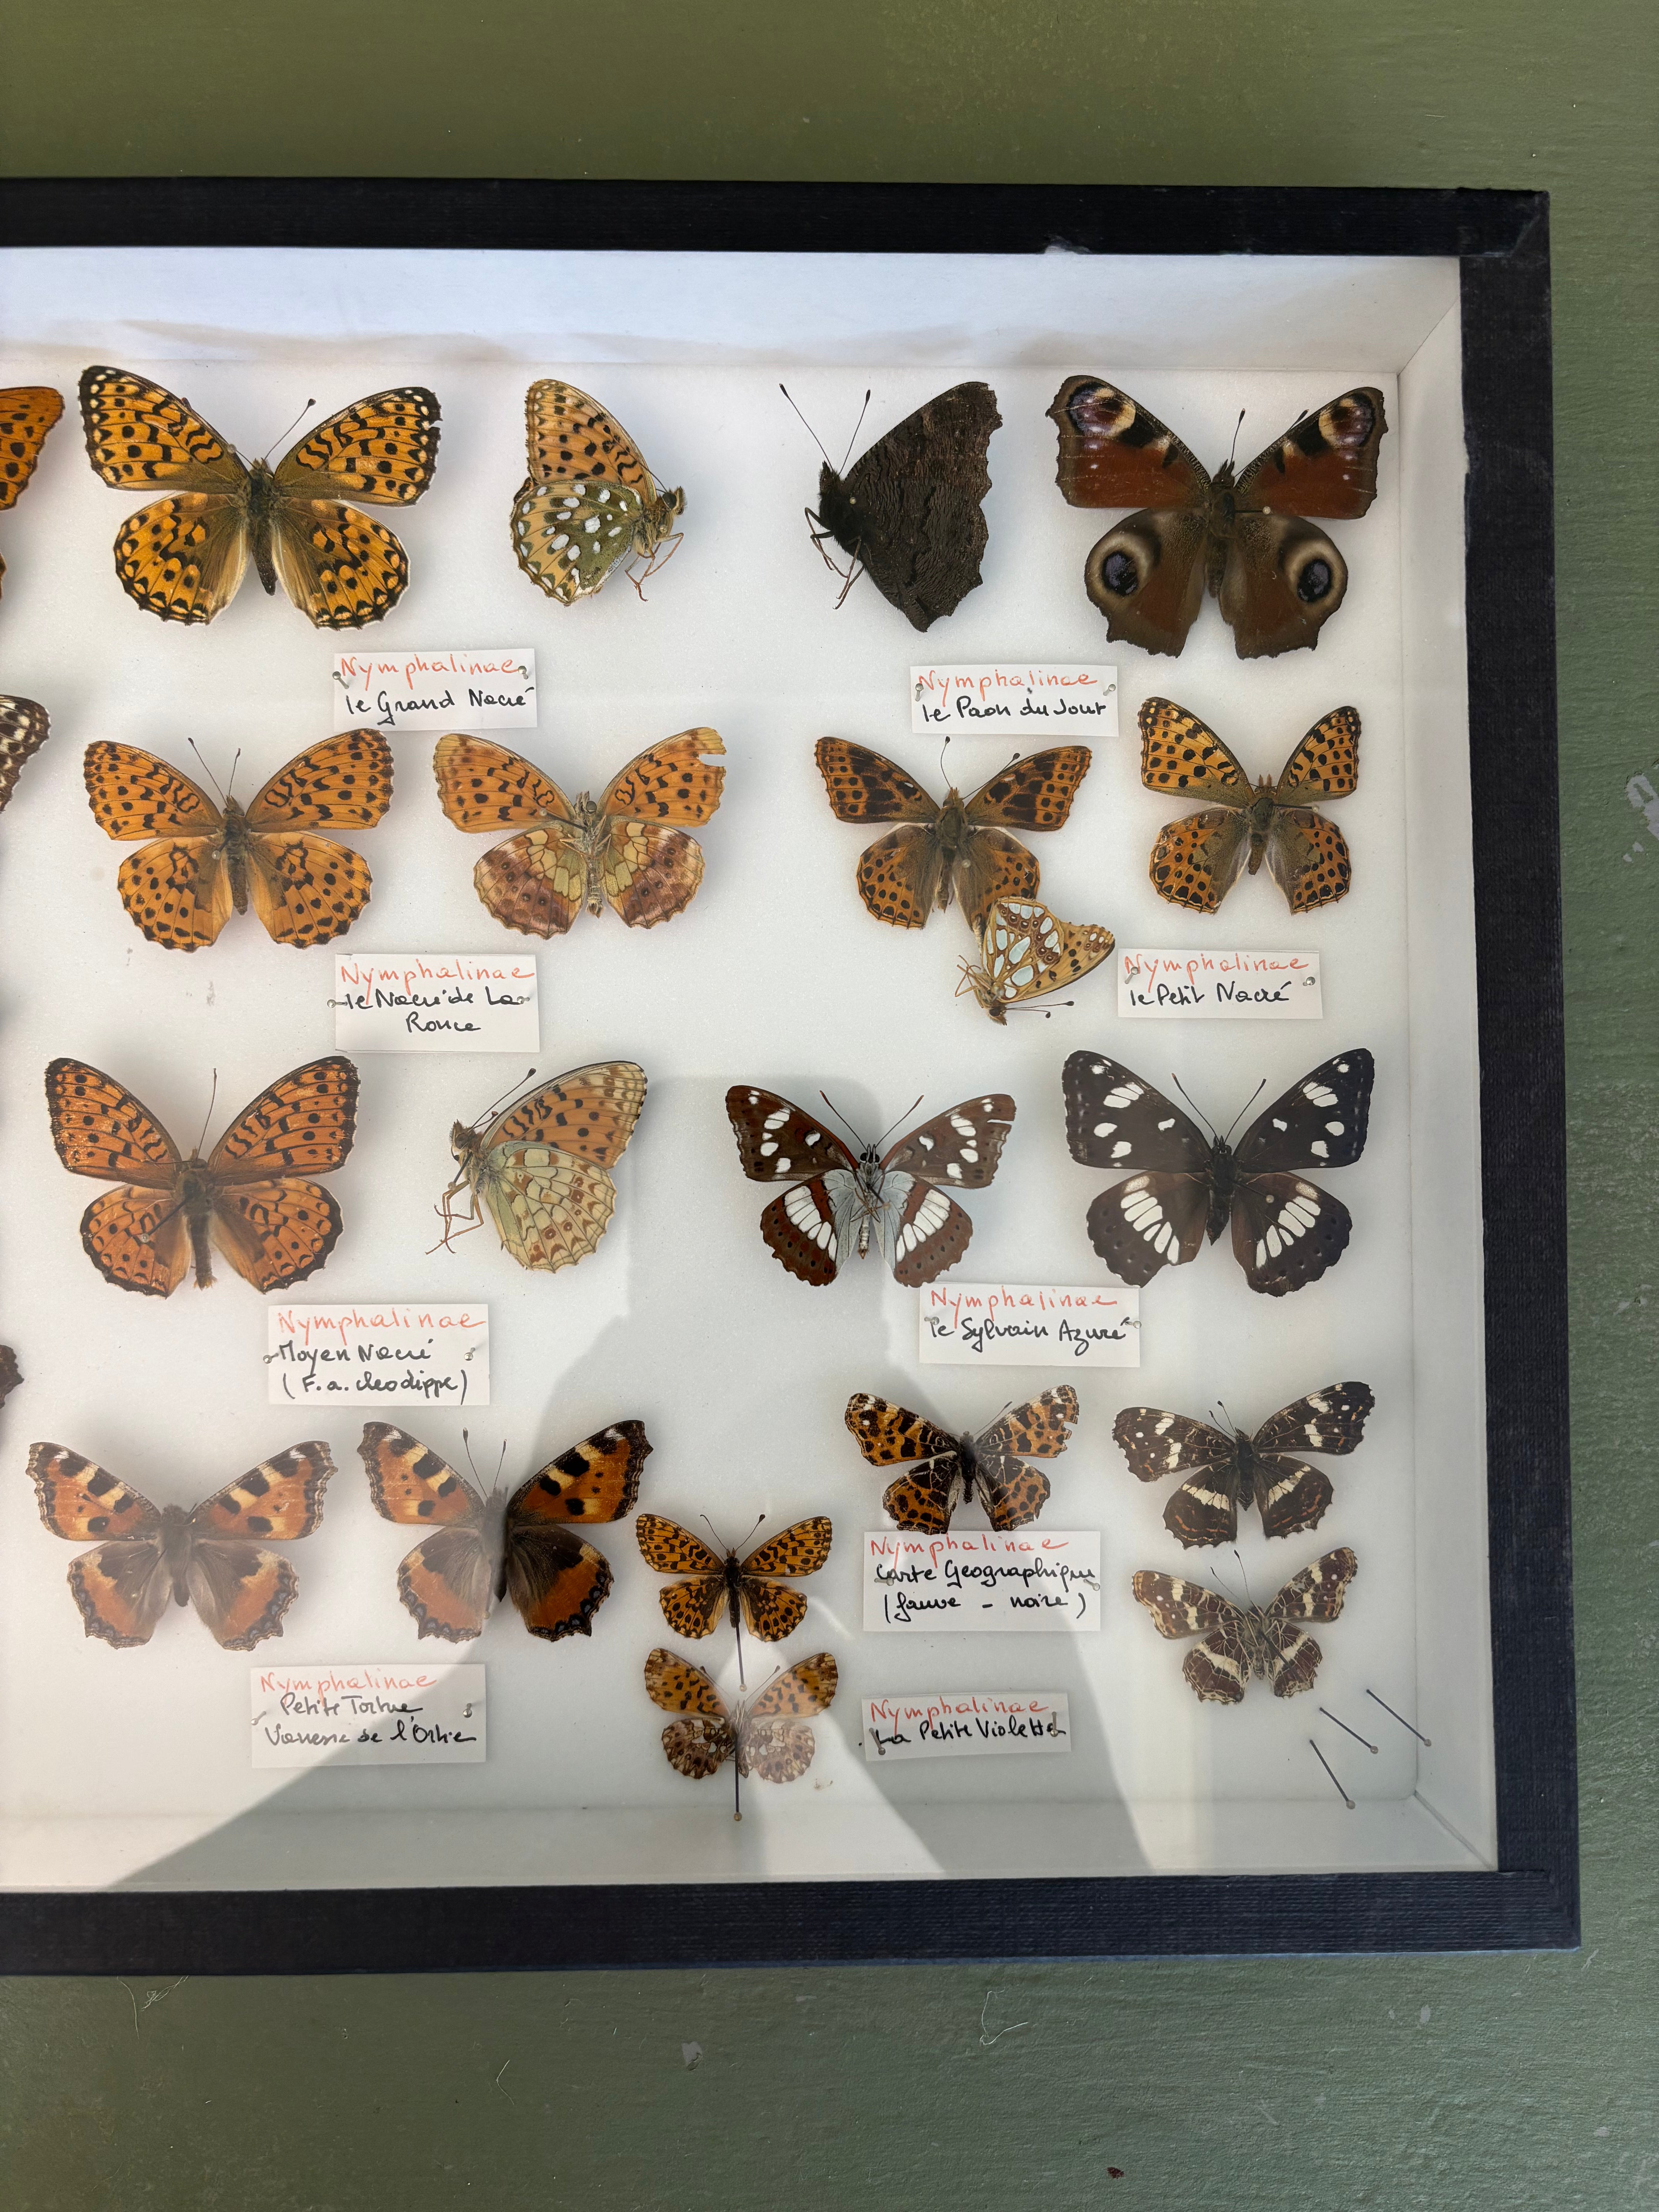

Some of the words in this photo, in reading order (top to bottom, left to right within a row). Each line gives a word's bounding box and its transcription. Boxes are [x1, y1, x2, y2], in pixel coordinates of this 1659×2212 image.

[341, 654, 519, 690] Nymphalinae
[919, 670, 1097, 707] Nymphalinae
[346, 696, 371, 714] le
[377, 690, 455, 725] Grand
[922, 704, 950, 721] le
[957, 696, 1011, 718] Paon
[1020, 698, 1049, 716] du
[1053, 698, 1106, 716] Jour
[341, 959, 535, 1005] Nymphalinae
[1125, 953, 1309, 993] Nymphalinae
[346, 994, 373, 1009] le
[448, 987, 474, 1004] de
[1131, 990, 1154, 1006] le
[1157, 983, 1204, 1006] Petit
[1217, 981, 1291, 1003] Nacré
[931, 1286, 1117, 1329] Nymphalinae
[278, 1308, 486, 1346] Nymphalinae
[930, 1321, 955, 1337] le
[961, 1317, 1048, 1352] Sylvain
[1059, 1317, 1130, 1357] Azuré
[279, 1340, 351, 1375] Moyen
[871, 1533, 1069, 1570] Nymphalinae
[876, 1563, 937, 1583] Carte
[260, 1668, 437, 1707] Nymphalinae
[280, 1692, 340, 1717] Petite
[341, 1695, 423, 1715] Tortue
[265, 1723, 350, 1746] Vanesse
[357, 1729, 383, 1742] de
[390, 1716, 476, 1744] l'Ortie
[871, 1695, 1049, 1736] Nymphalinae
[920, 1720, 972, 1740] Petite
